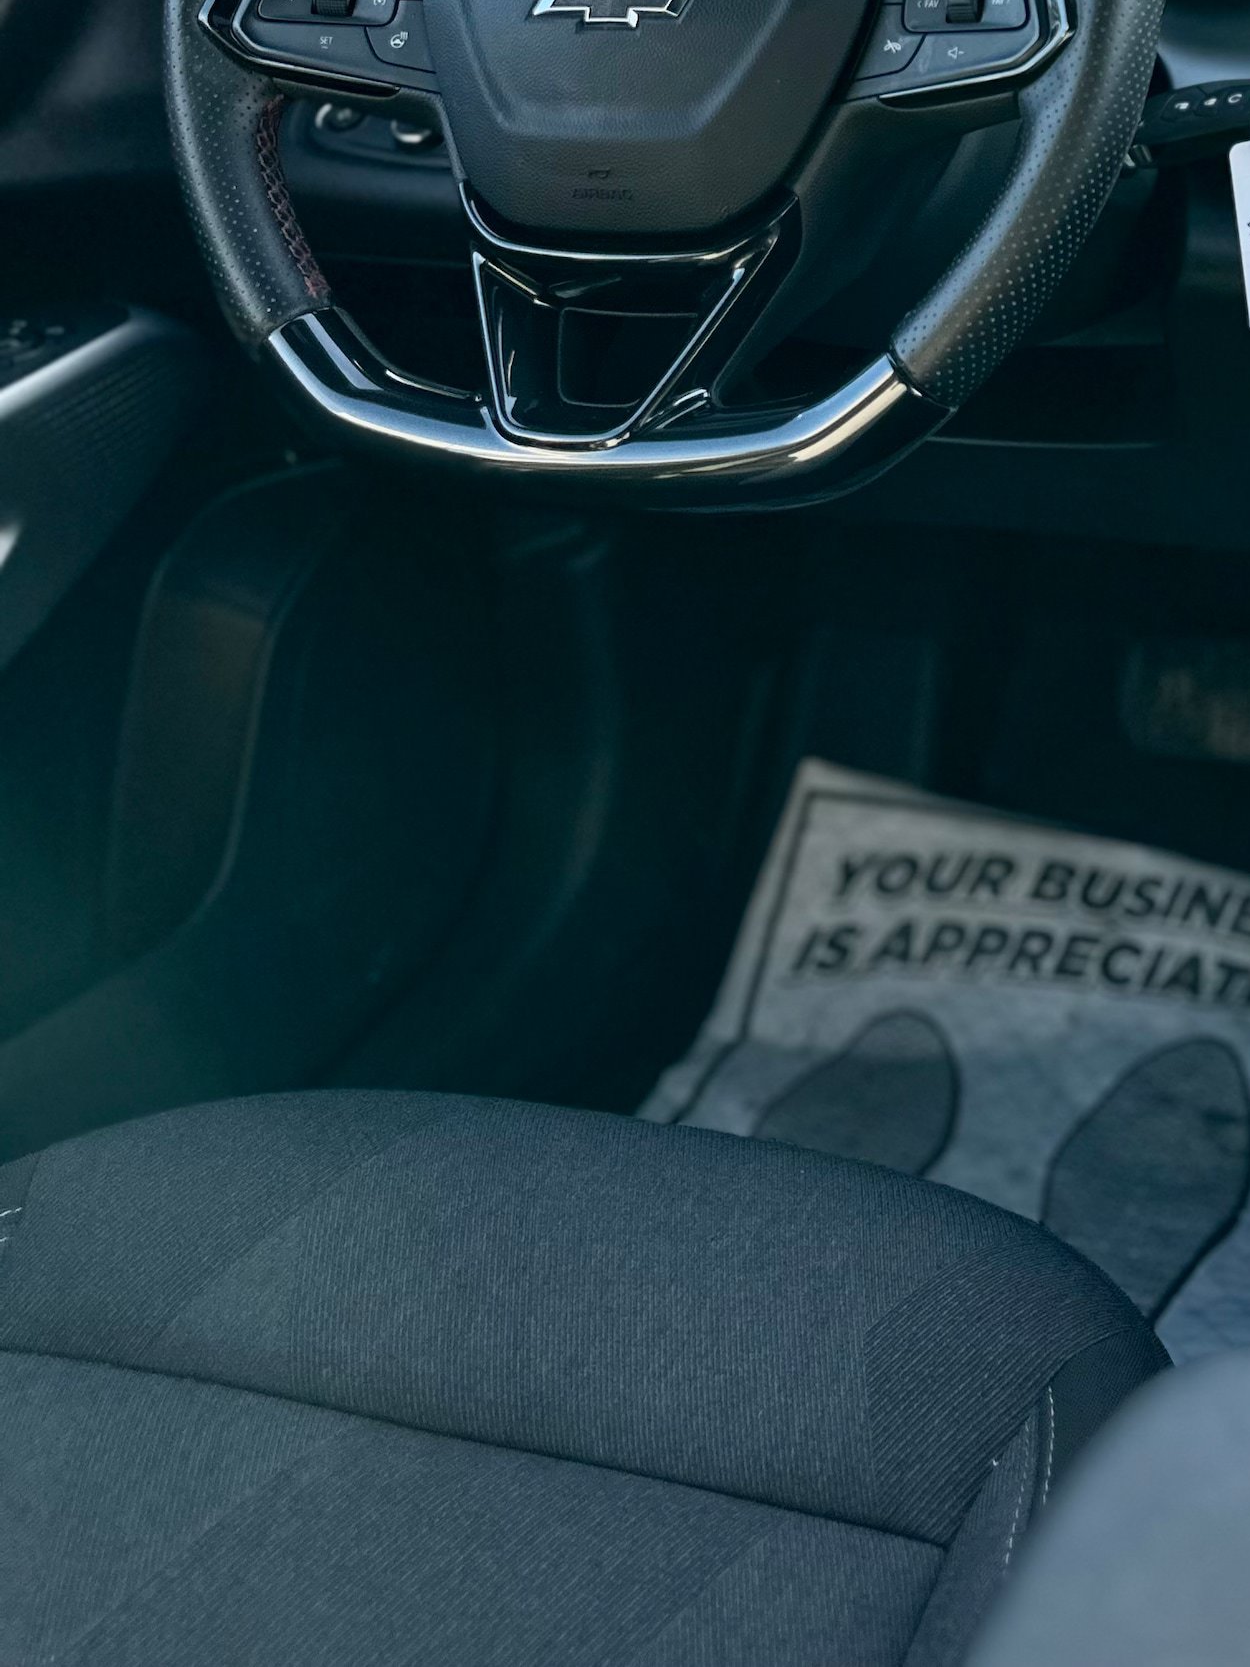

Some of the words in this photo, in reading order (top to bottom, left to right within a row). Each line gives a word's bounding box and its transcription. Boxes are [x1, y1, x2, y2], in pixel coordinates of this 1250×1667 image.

[924, 0, 940, 8] FAV
[320, 36, 333, 45] SET
[833, 851, 1017, 901] YOUR
[795, 923, 859, 975] IS
